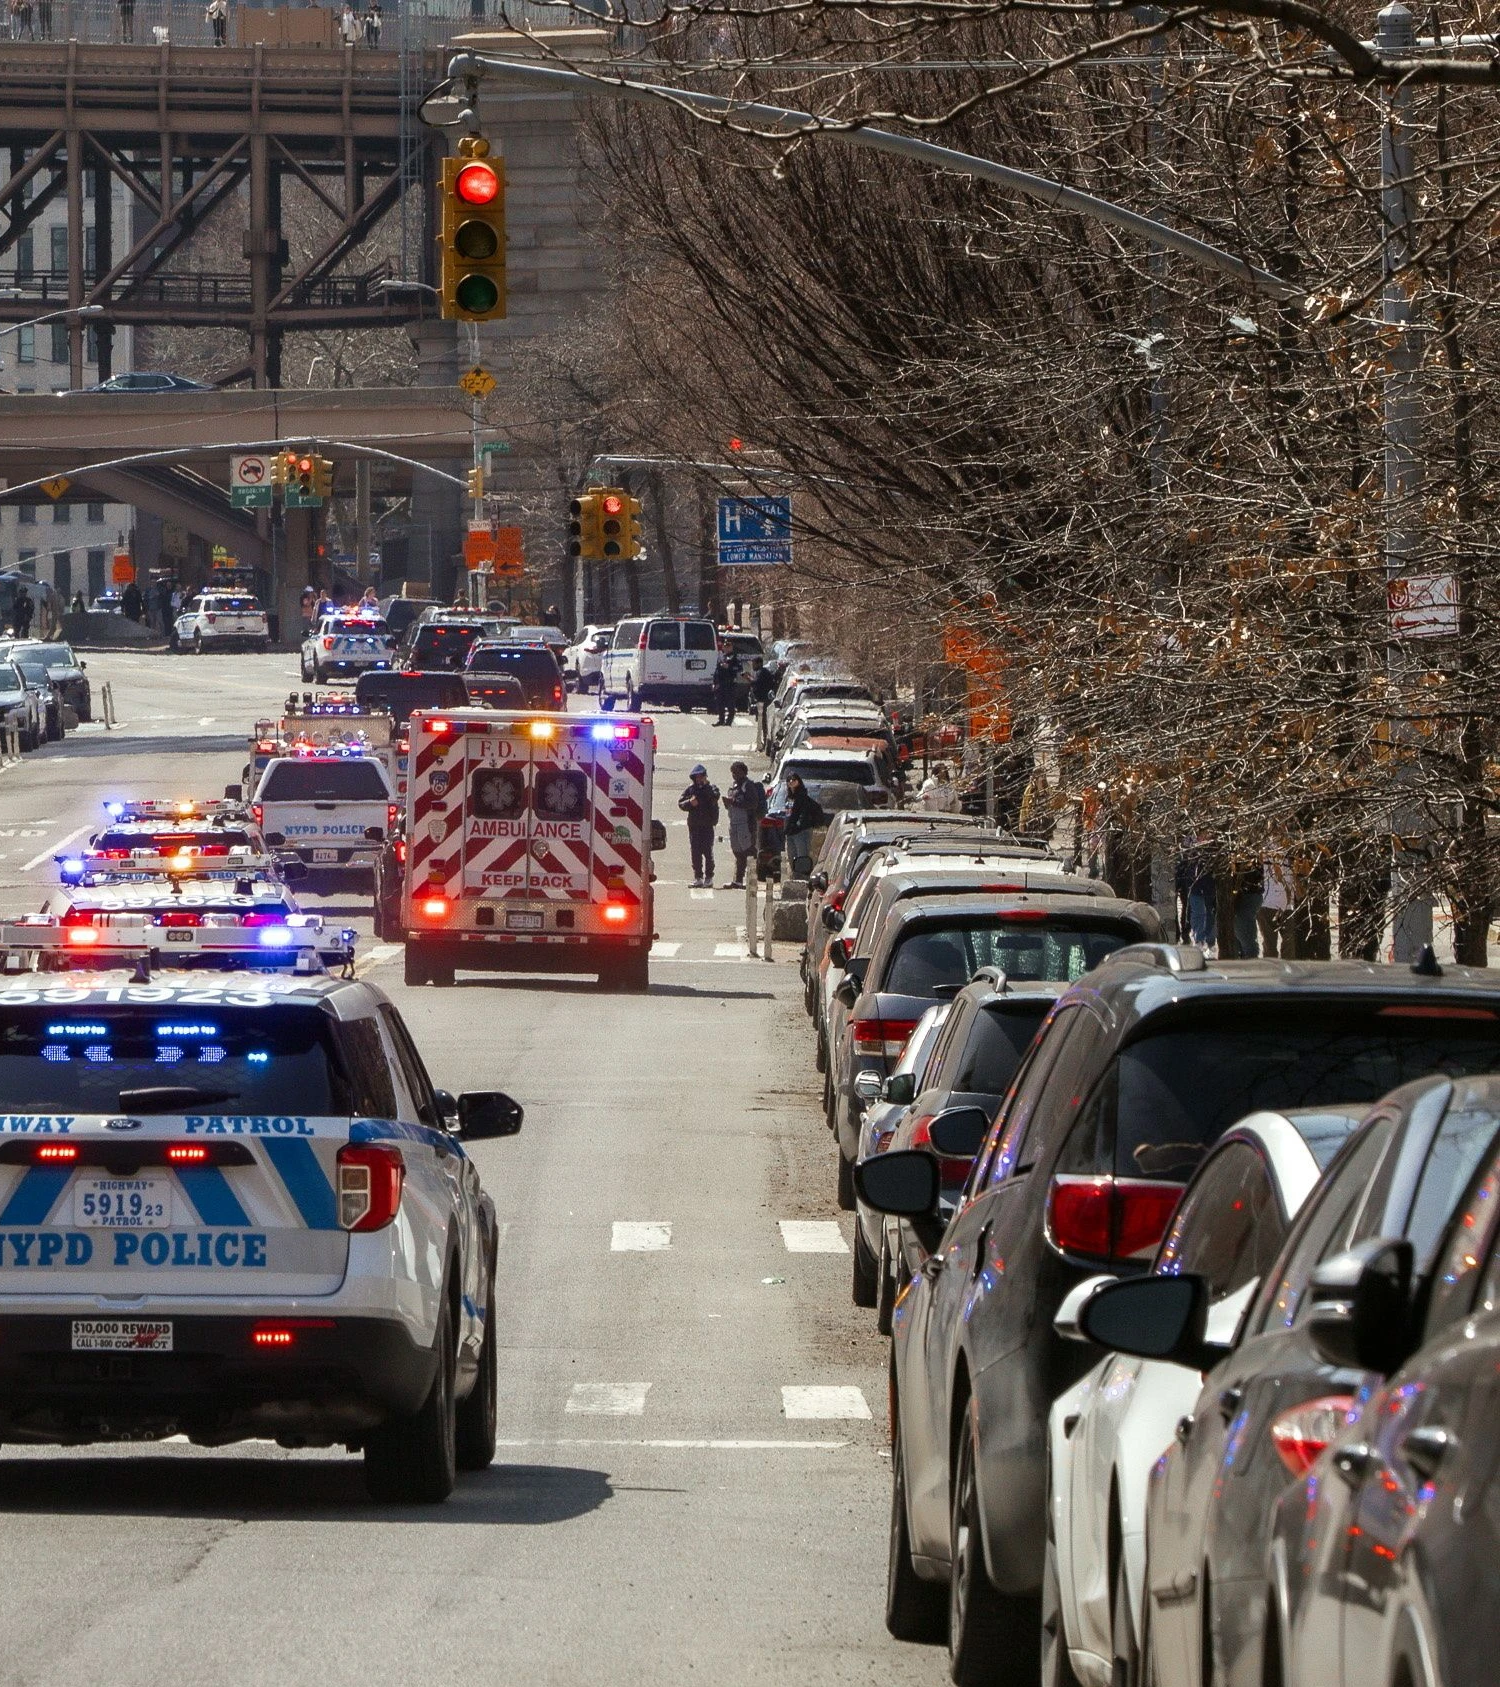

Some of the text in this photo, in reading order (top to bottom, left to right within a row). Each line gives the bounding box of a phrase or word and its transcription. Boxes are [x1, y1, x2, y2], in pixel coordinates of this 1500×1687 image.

[285, 825, 365, 835] NYPD POLICE
[470, 820, 581, 839] AMBULANCE
[481, 874, 573, 888] KEEP BACK
[185, 1116, 315, 1136] PATROL
[99, 1181, 148, 1191] HIGHWAY
[83, 1192, 163, 1217] 5919 23
[101, 1216, 143, 1226] PATROL
[114, 1233, 266, 1268] POLICE
[73, 1322, 170, 1335] $10,000 REWARD
[76, 1339, 92, 1348] CALL
[95, 1340, 113, 1348] 1-800
